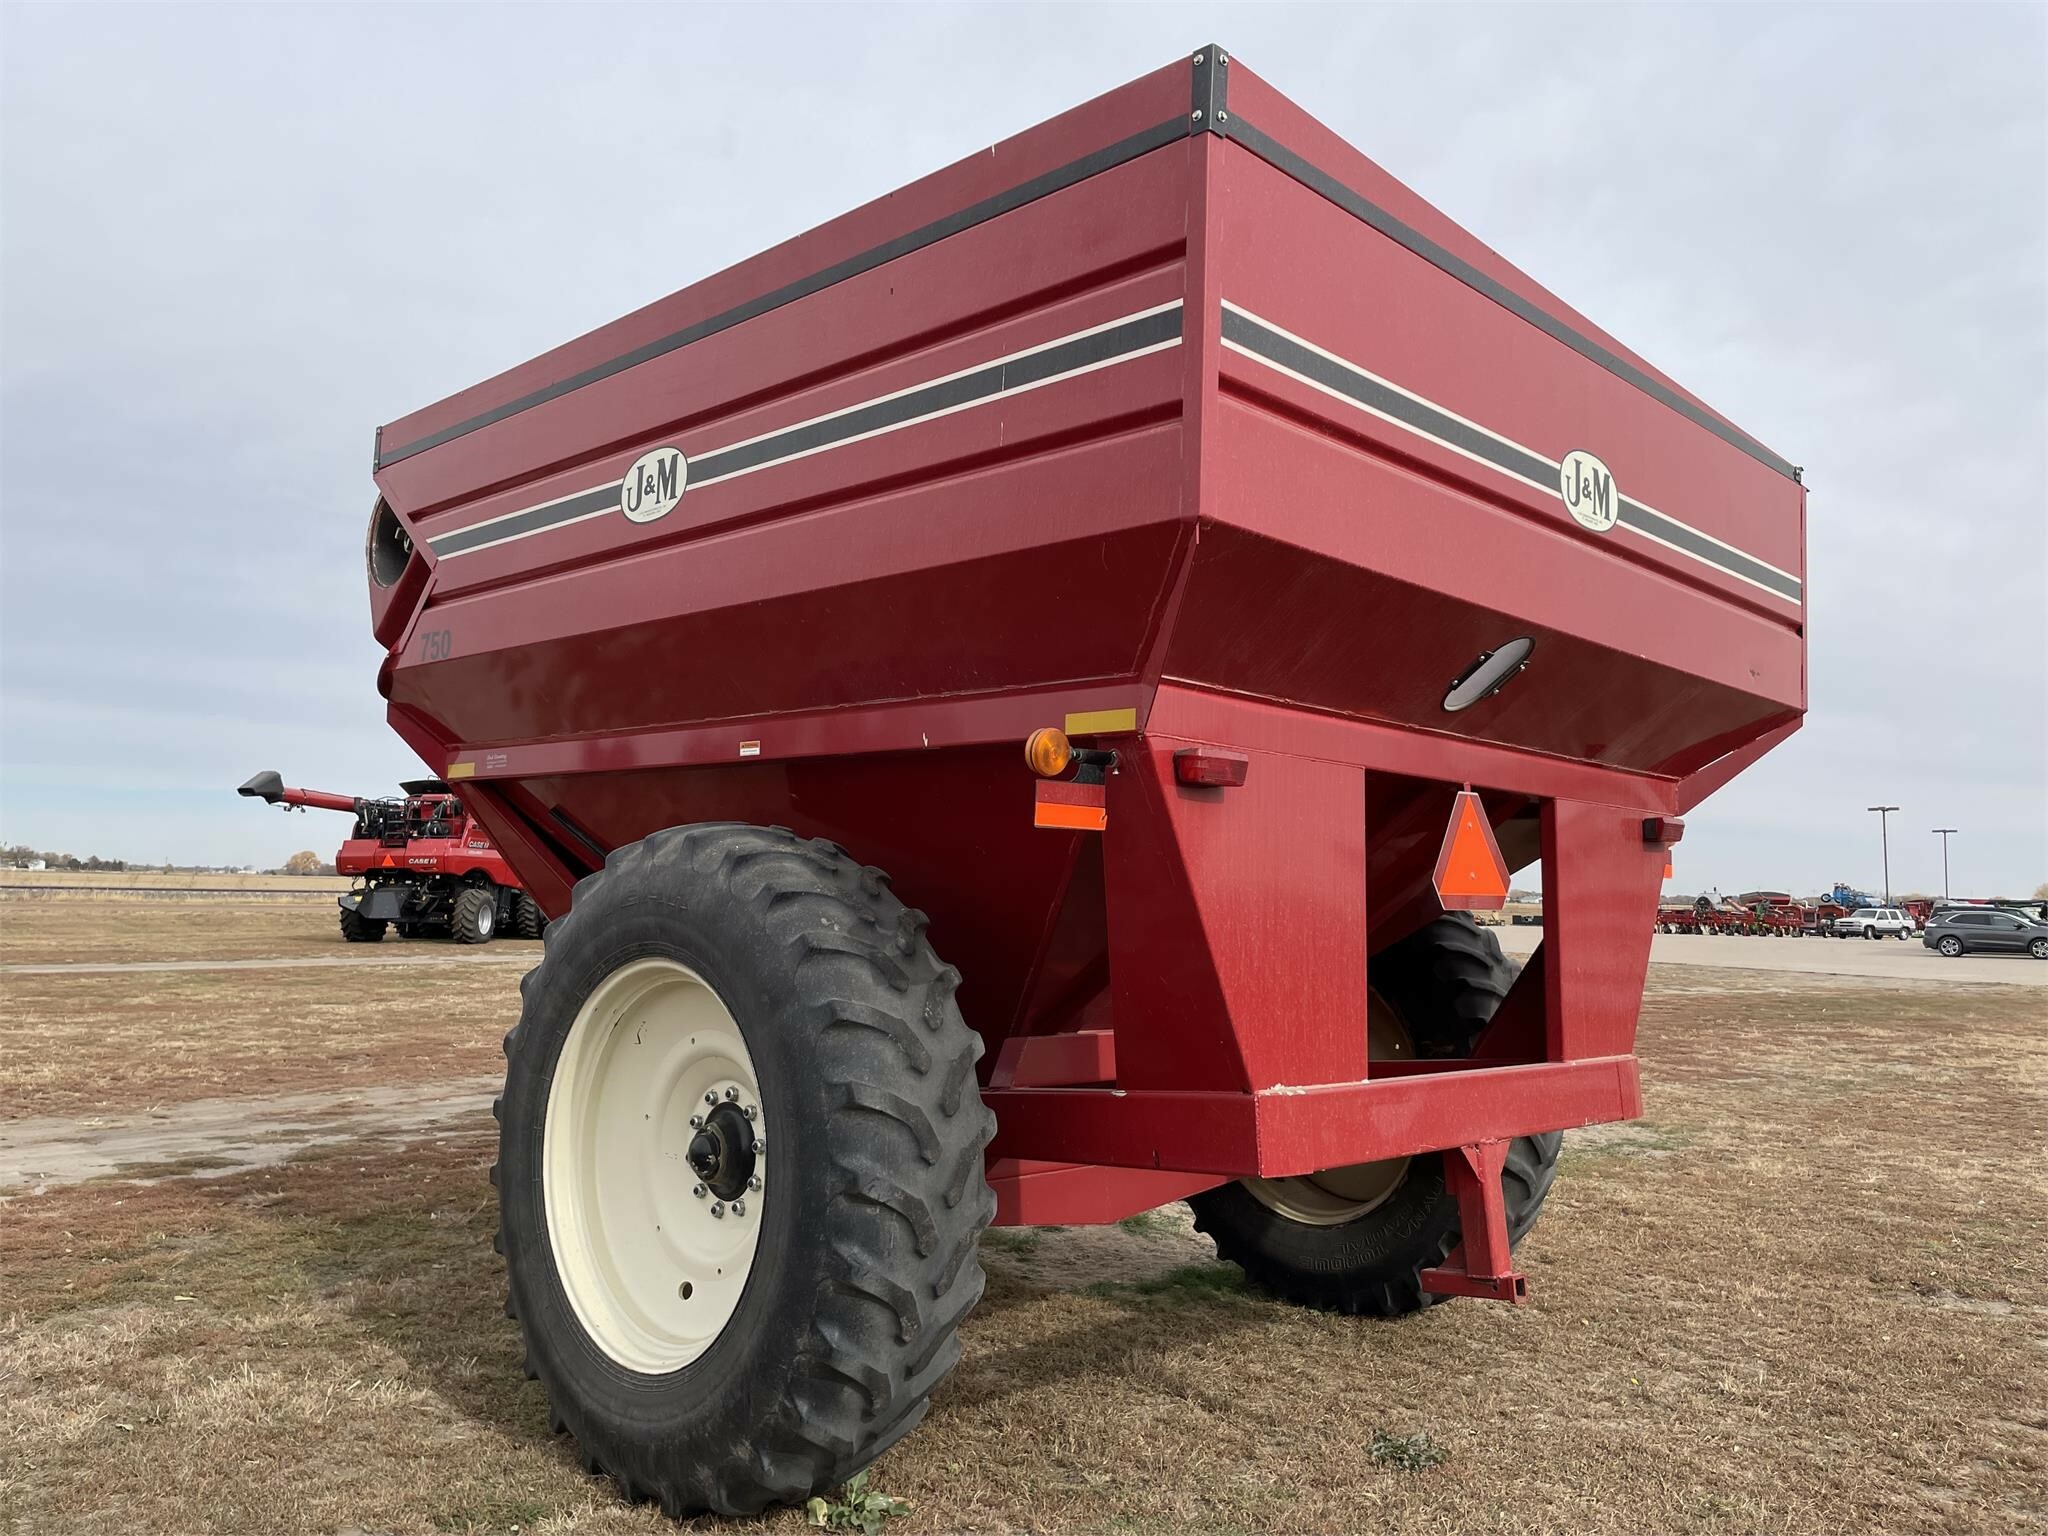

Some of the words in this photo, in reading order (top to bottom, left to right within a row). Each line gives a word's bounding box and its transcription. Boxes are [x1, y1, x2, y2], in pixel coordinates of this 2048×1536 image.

[626, 452, 680, 513] J&M
[1565, 458, 1612, 522] J&M
[421, 629, 452, 662] 750
[468, 840, 483, 849] CASE
